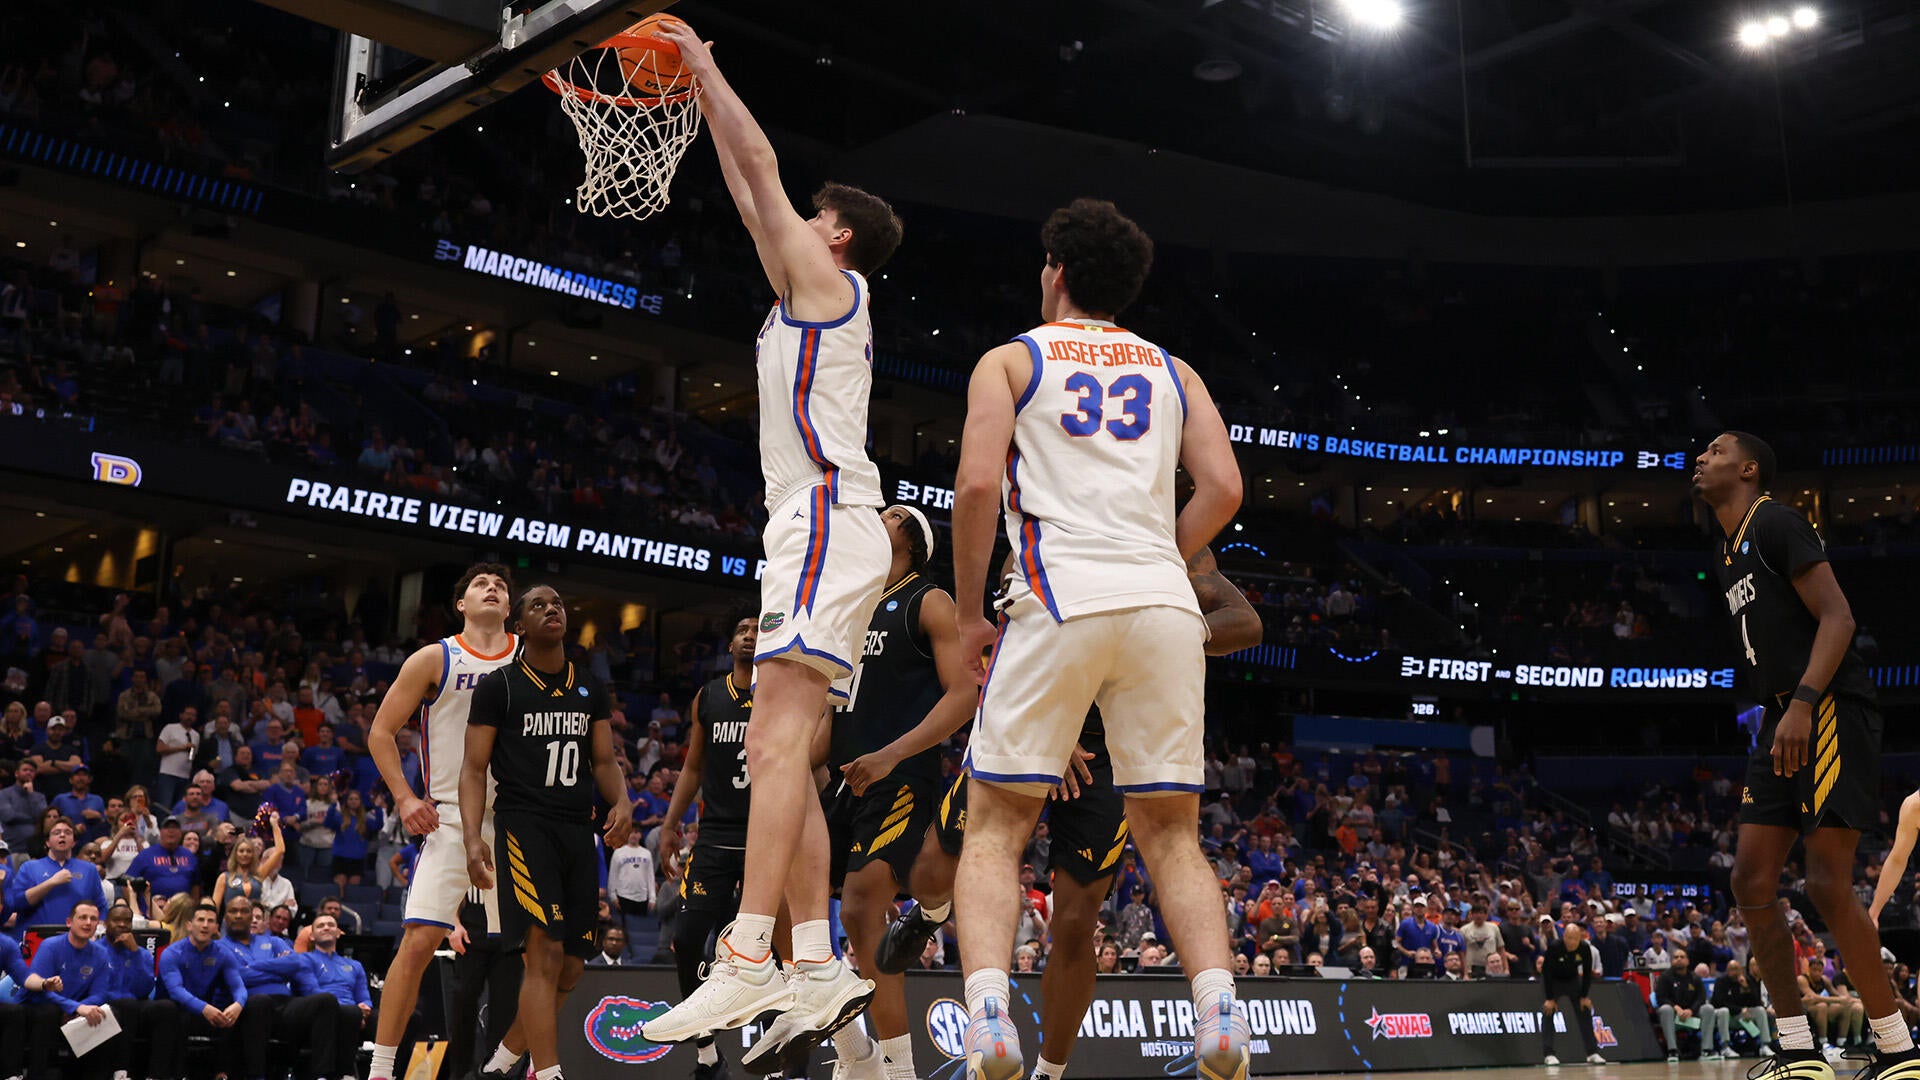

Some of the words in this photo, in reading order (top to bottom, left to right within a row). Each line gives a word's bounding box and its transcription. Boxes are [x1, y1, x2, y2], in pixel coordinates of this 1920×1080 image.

[1046, 340, 1163, 367] JOSEFSBERG
[1060, 371, 1153, 441] 33
[1230, 424, 1254, 443] DI
[1259, 428, 1319, 450] MEN'S
[1325, 436, 1448, 463] BASKETBALL
[1455, 447, 1624, 467] CHAMPIONSHIP
[922, 485, 955, 510] FIR
[286, 478, 421, 523] PRAIRIE
[429, 502, 504, 537] VIEW
[506, 517, 571, 548] A&M
[576, 529, 711, 572] PANTHERS
[721, 556, 747, 577] VS
[1427, 658, 1492, 682] FIRST
[1515, 664, 1604, 688] SECOND
[1611, 667, 1708, 688] ROUNDS
[522, 712, 591, 737] PANTHERS
[545, 740, 580, 787] 10
[1077, 1000, 1147, 1037] NCAA
[1385, 1013, 1433, 1038] SWAC
[1448, 1012, 1504, 1035] PRAIRIE
[1502, 1012, 1537, 1034] VIEW
